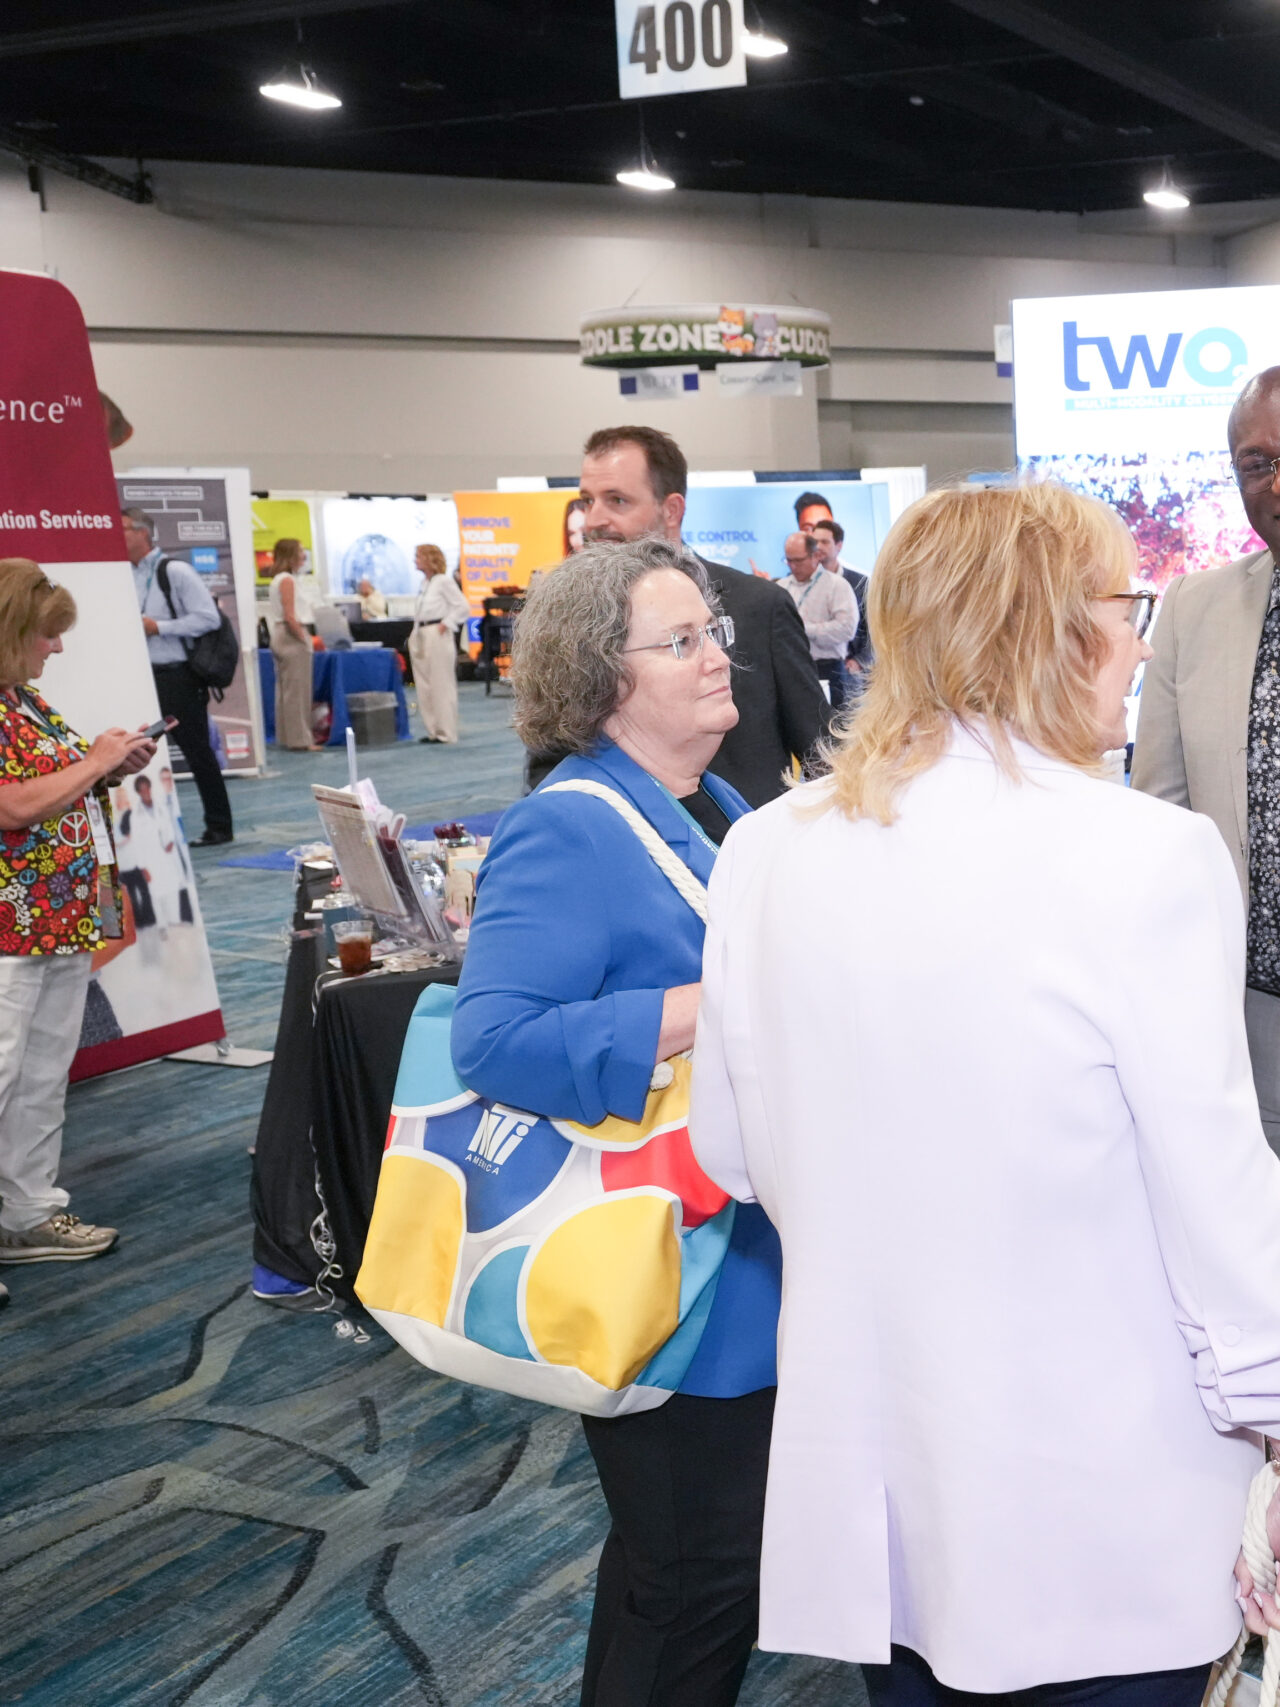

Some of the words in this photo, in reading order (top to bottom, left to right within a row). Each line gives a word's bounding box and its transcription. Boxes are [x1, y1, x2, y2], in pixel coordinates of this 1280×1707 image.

[629, 0, 733, 74] 400
[637, 323, 723, 352] ZONE
[0, 509, 37, 529] tion
[40, 509, 113, 529] Services
[462, 517, 512, 528] IMPROVE
[462, 530, 495, 542] YOUR
[697, 529, 758, 543] CONTROL
[465, 557, 514, 568] QUALITY
[466, 570, 481, 581] OF
[484, 570, 509, 582] LIFE
[465, 1153, 501, 1176] AMERICA
